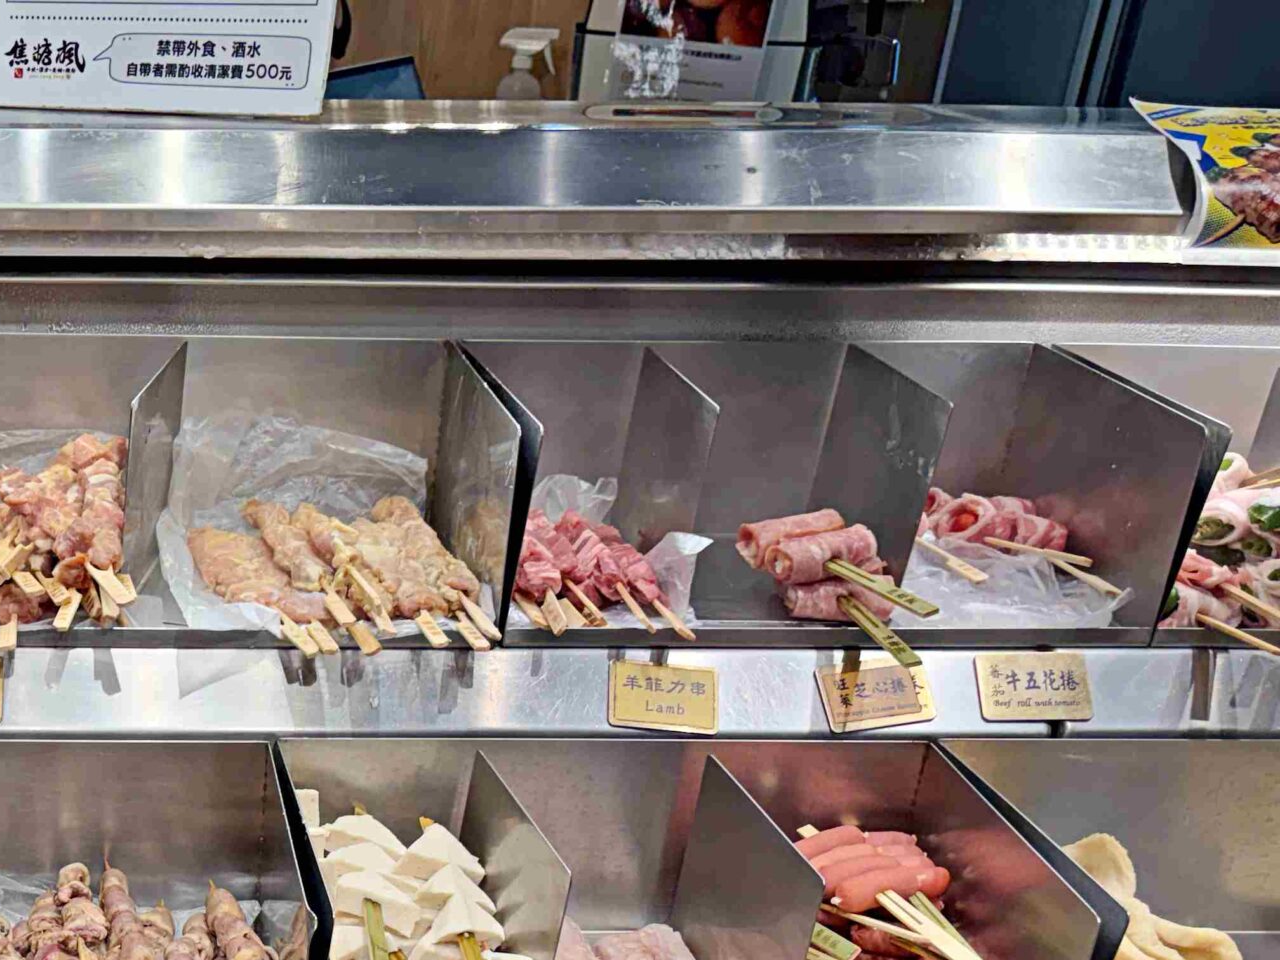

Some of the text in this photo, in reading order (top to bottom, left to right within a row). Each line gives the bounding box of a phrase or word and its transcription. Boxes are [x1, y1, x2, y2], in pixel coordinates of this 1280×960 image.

[156, 40, 261, 58] 禁帶外食、酒水
[645, 700, 685, 715] Lamb
